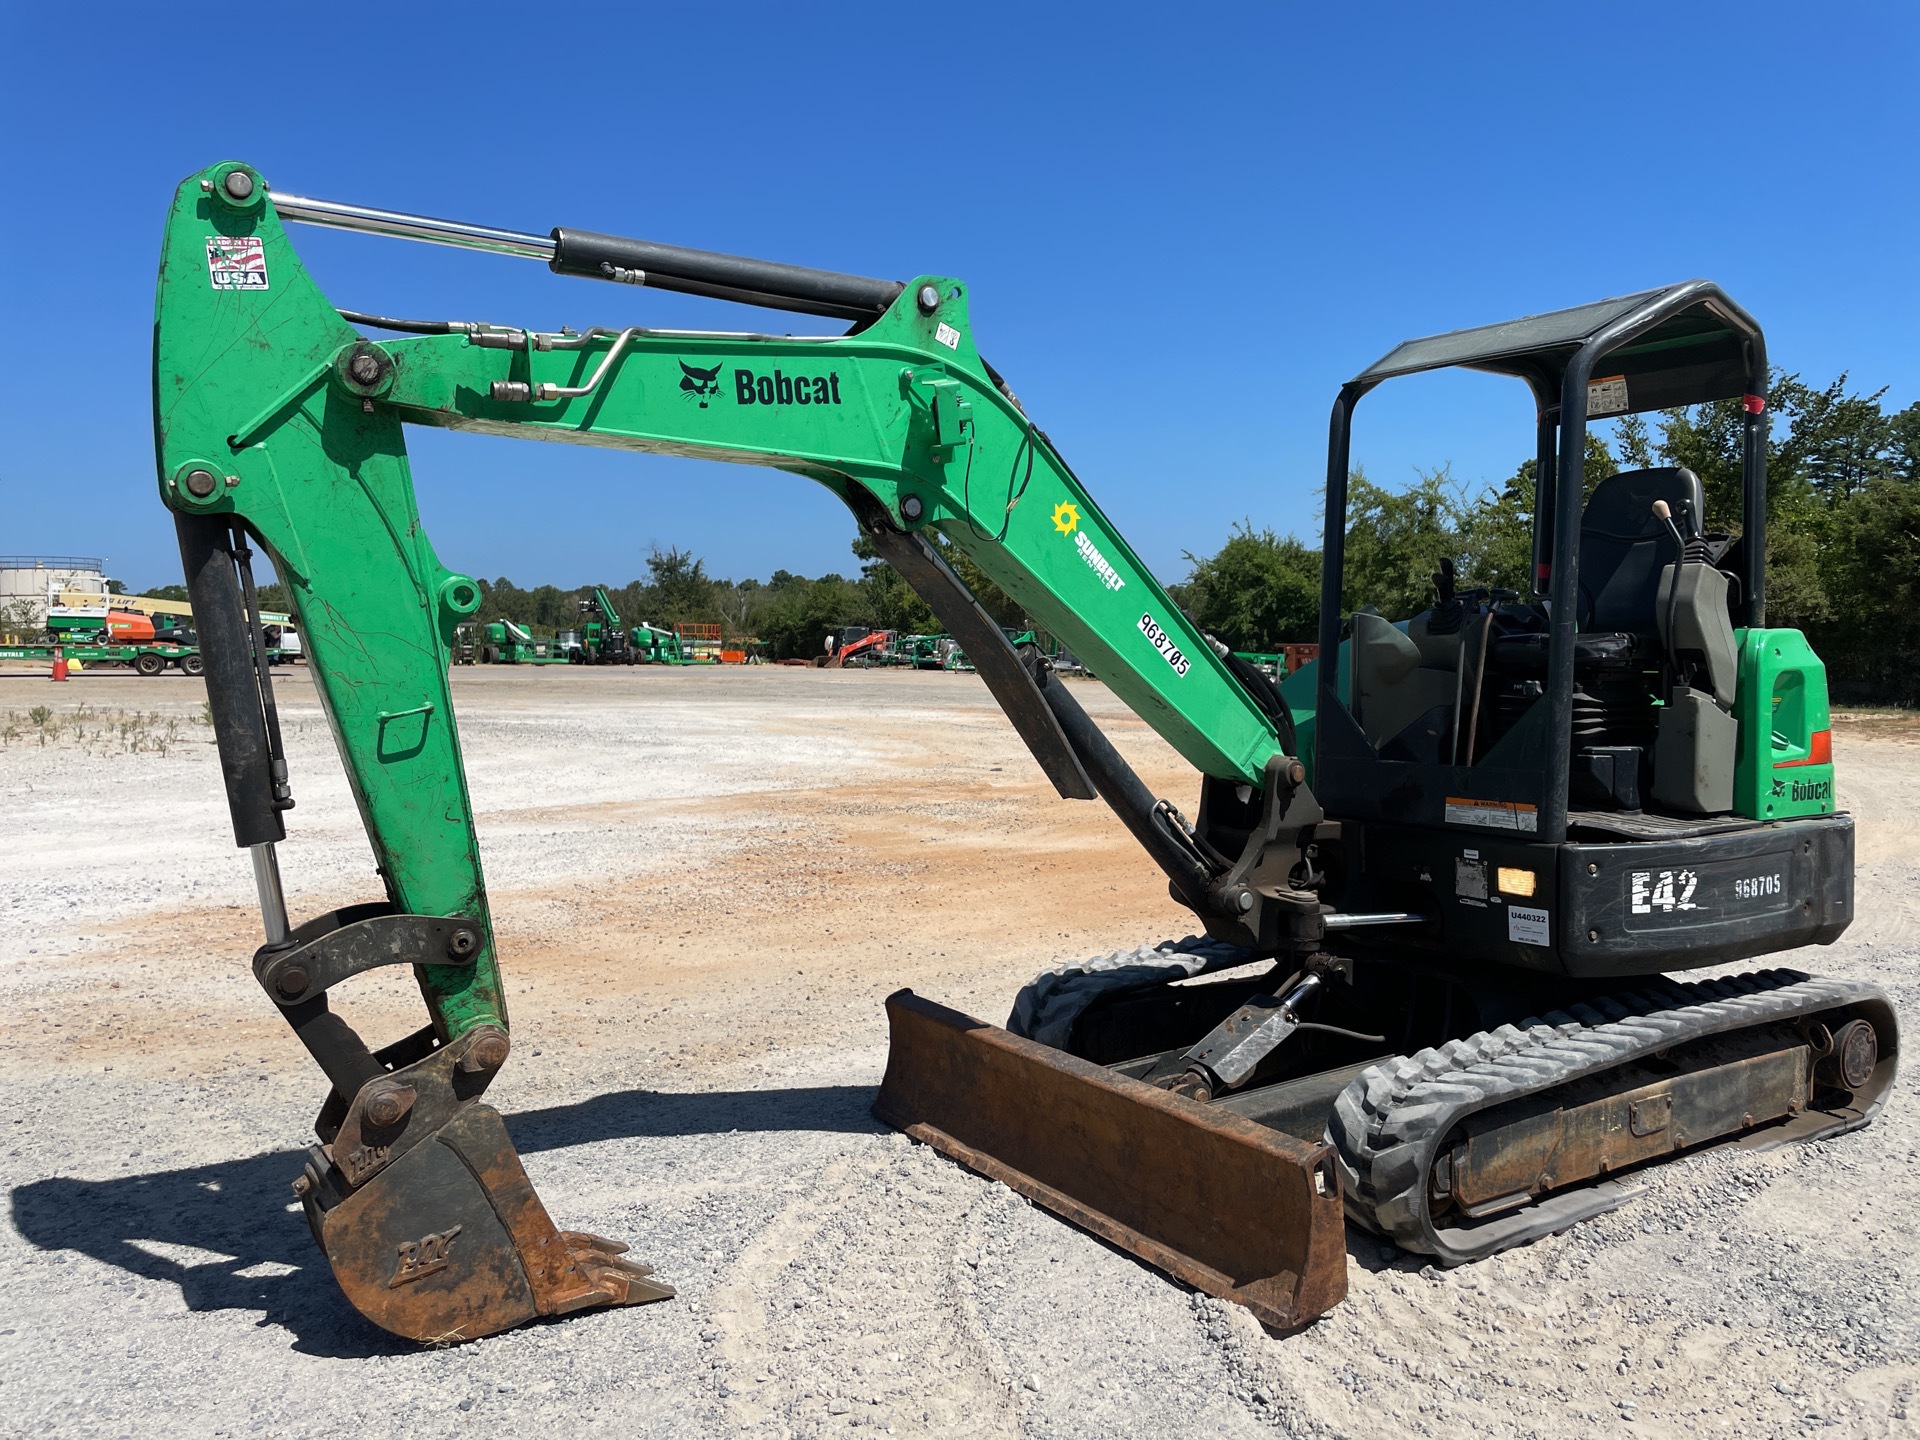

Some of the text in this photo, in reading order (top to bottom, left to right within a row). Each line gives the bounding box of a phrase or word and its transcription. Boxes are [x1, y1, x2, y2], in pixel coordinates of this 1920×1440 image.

[214, 272, 264, 284] USA
[734, 369, 842, 405] Bobcat
[1074, 530, 1126, 592] SUNBELT
[1076, 547, 1112, 590] RENTALS
[1141, 614, 1190, 675] 968705
[1632, 870, 1697, 914] E42
[1735, 874, 1781, 899] 968705
[1511, 912, 1546, 923] U440322
